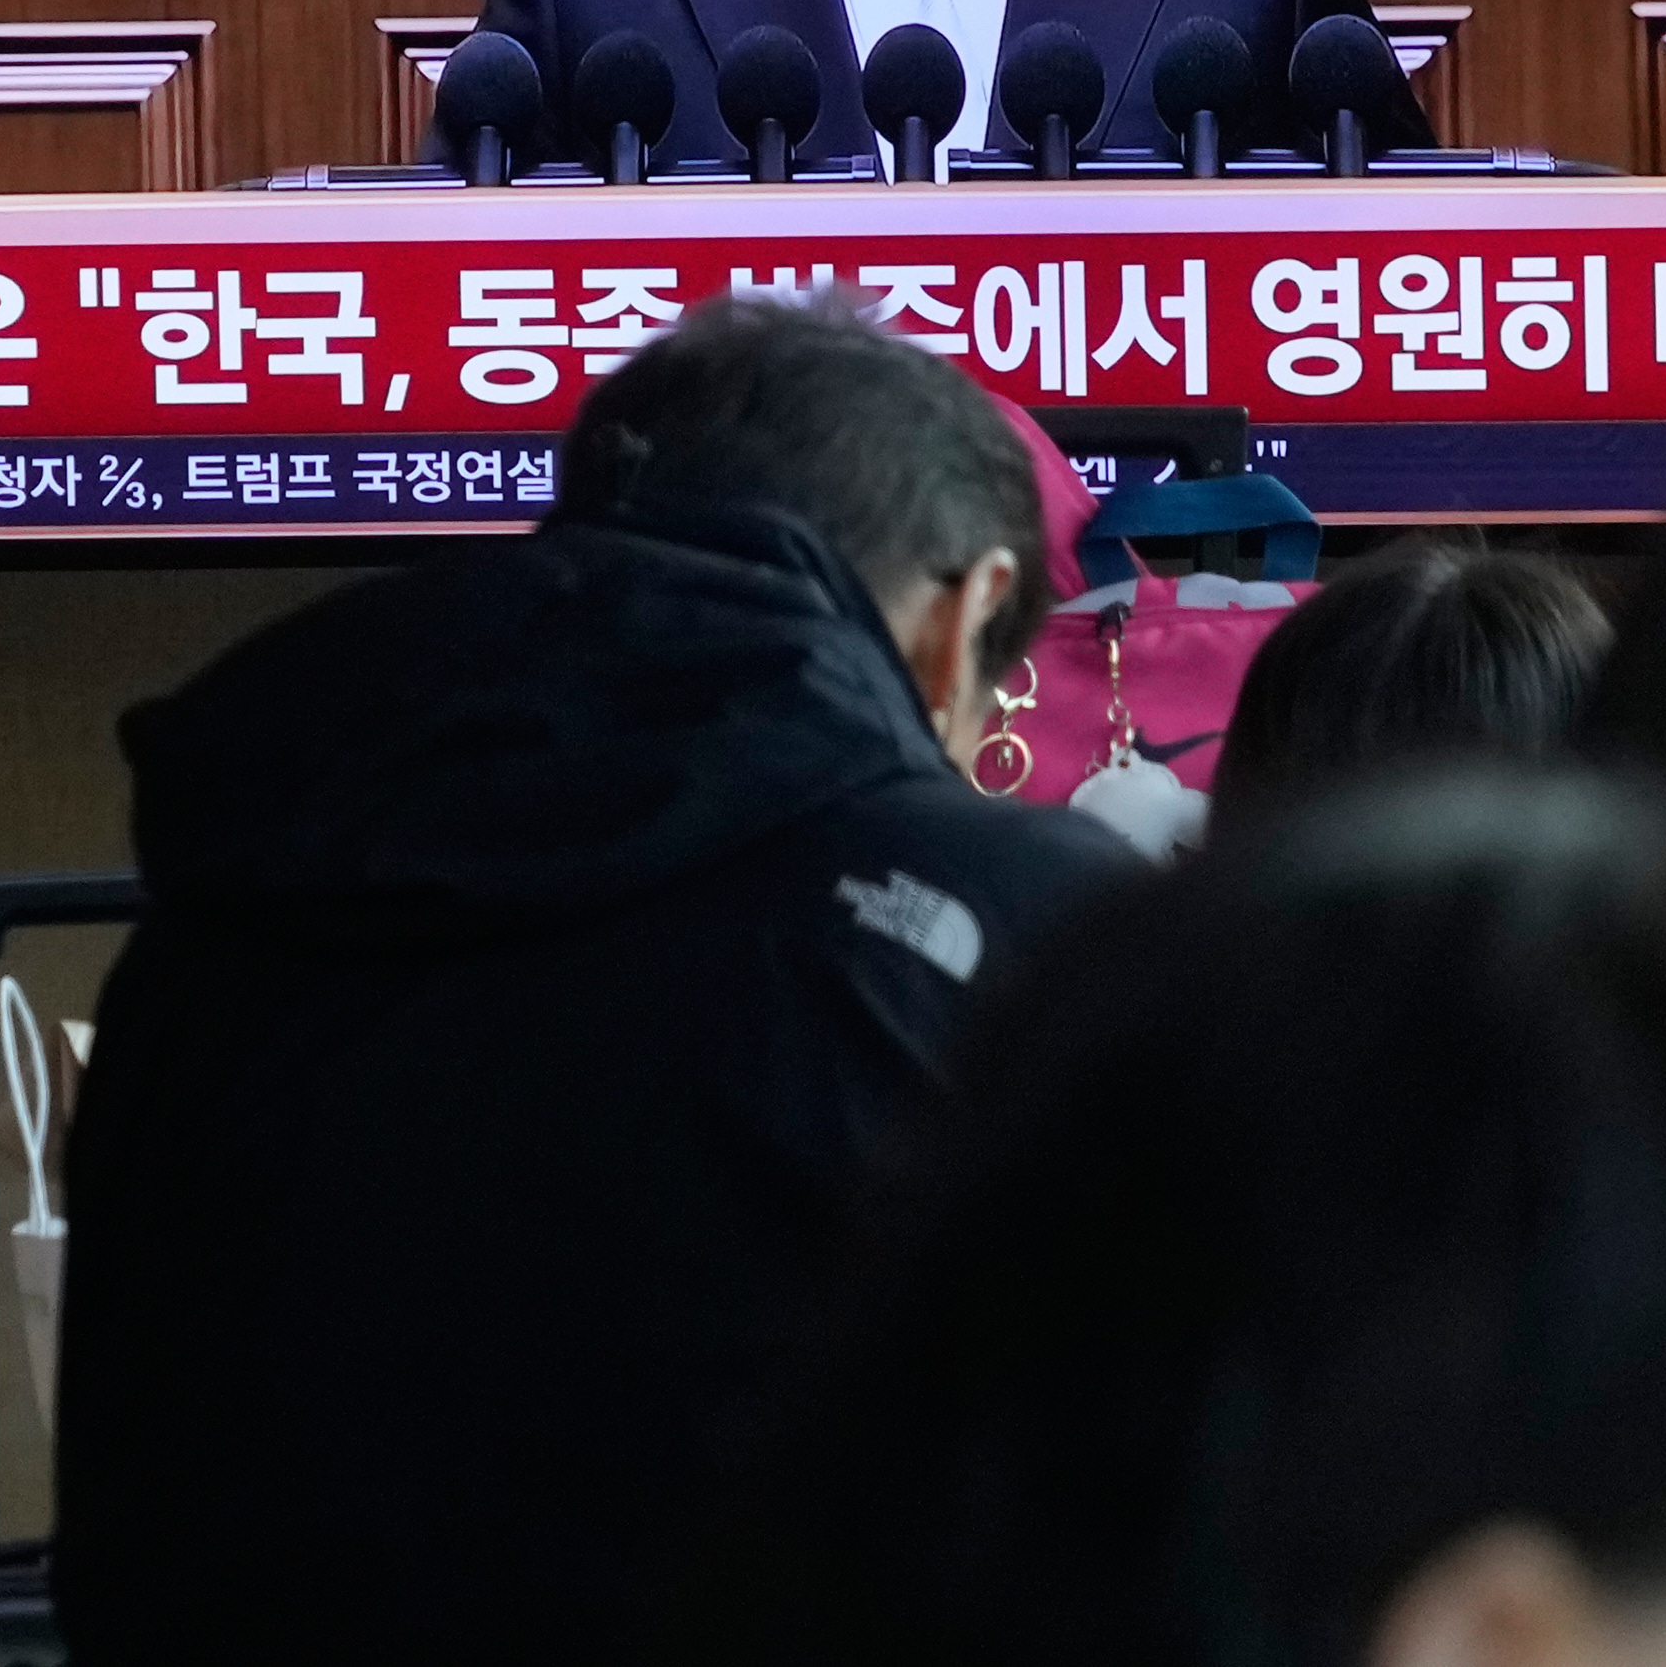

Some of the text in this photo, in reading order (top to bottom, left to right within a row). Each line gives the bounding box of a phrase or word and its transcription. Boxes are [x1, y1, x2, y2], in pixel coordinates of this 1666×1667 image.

[79, 267, 411, 412] "한국,
[1251, 254, 1609, 396] 영원히
[182, 452, 336, 504] 트럼프
